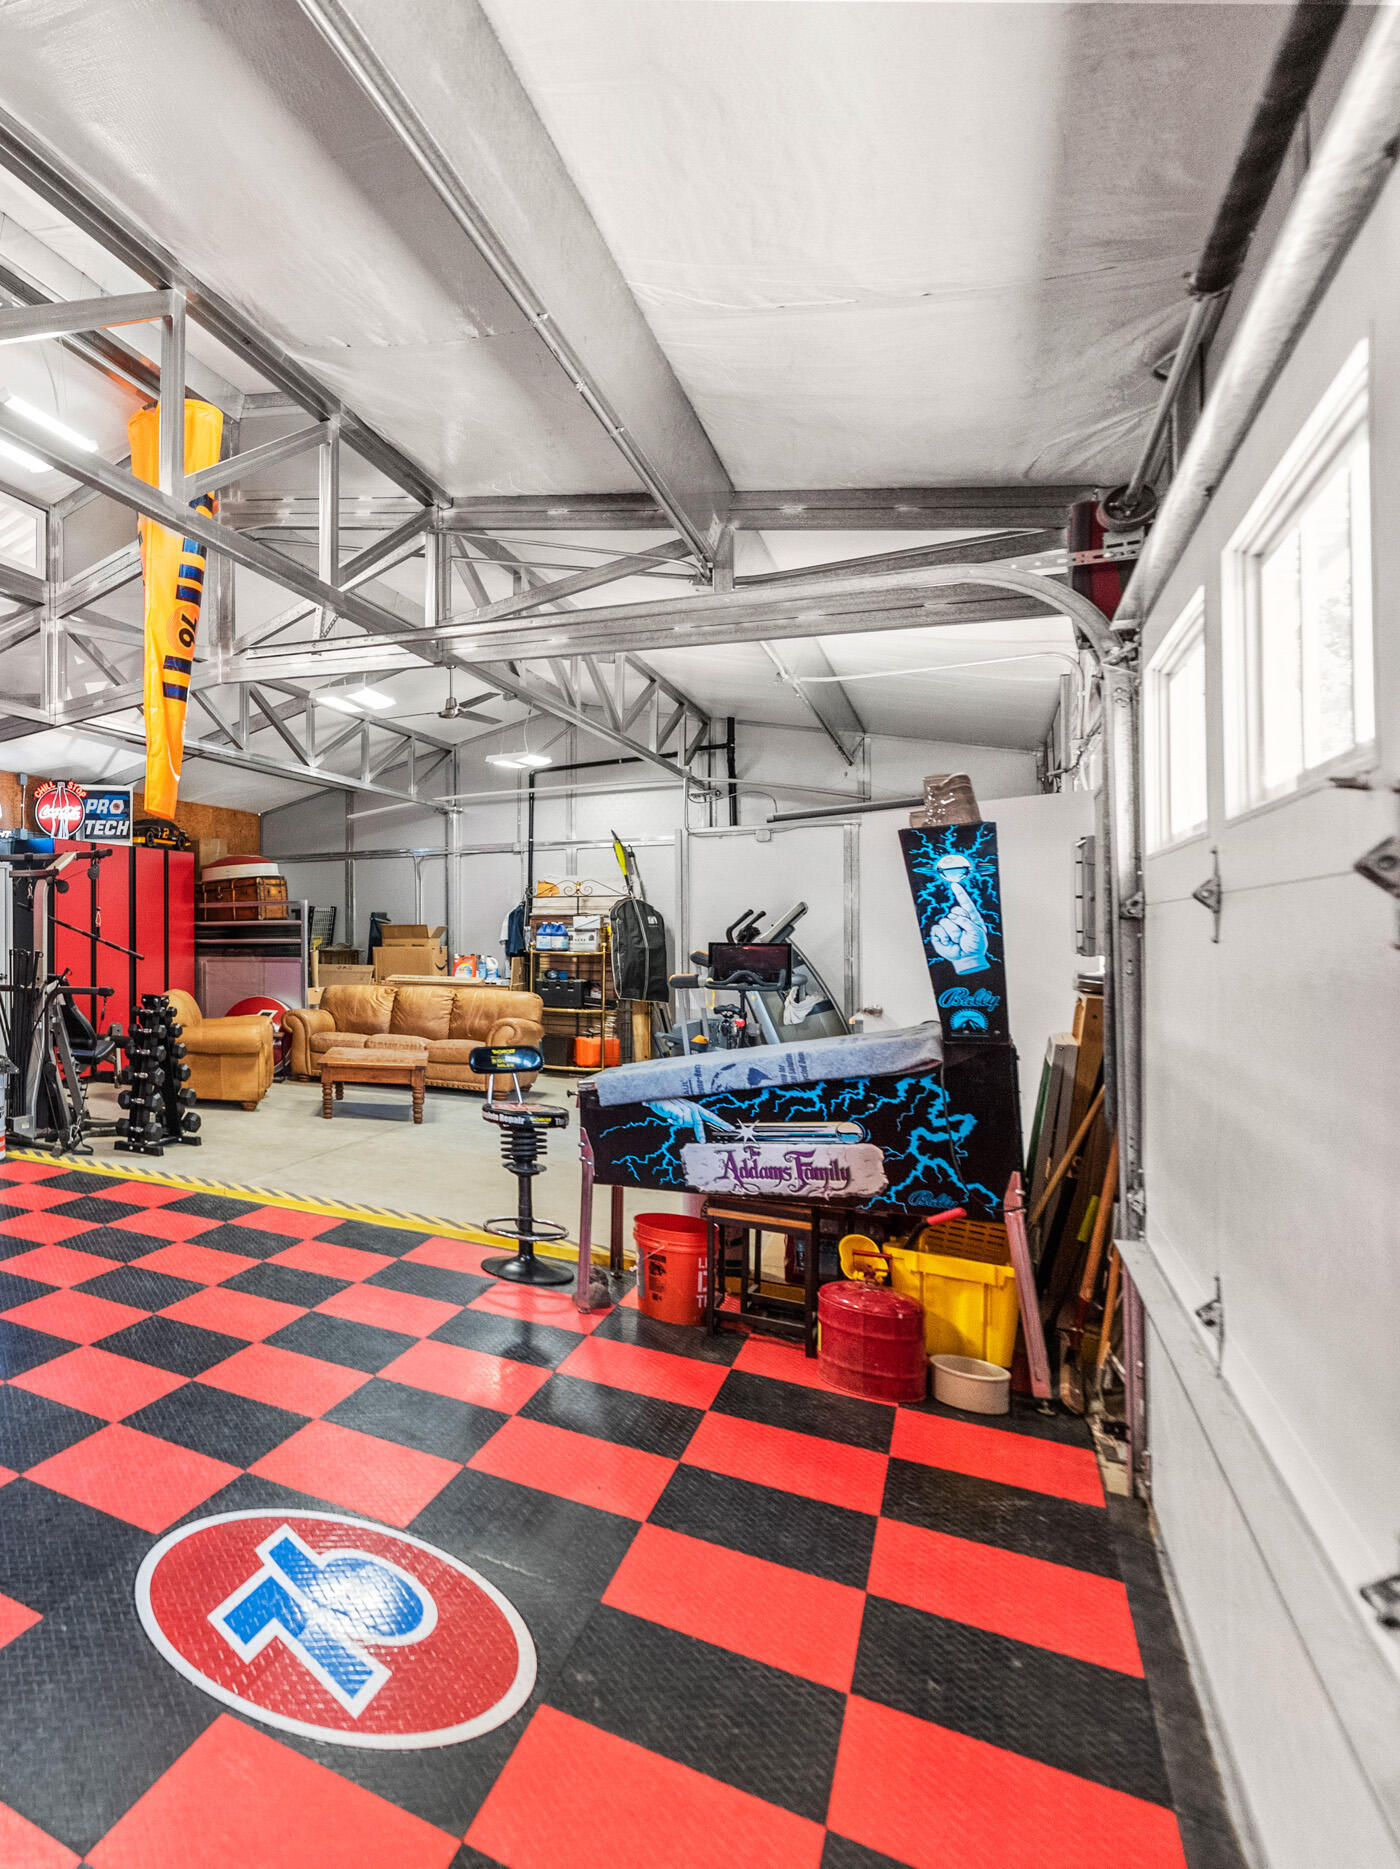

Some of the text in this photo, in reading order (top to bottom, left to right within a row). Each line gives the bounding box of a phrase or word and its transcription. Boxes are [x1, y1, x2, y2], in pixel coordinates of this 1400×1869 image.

[179, 613, 197, 648] 76
[34, 781, 87, 798] CHILL STOP
[86, 799, 124, 814] PRO
[85, 820, 130, 836] TECH
[162, 828, 169, 839] 2
[937, 986, 1001, 1012] Bally
[715, 1150, 852, 1194] Addams Family
